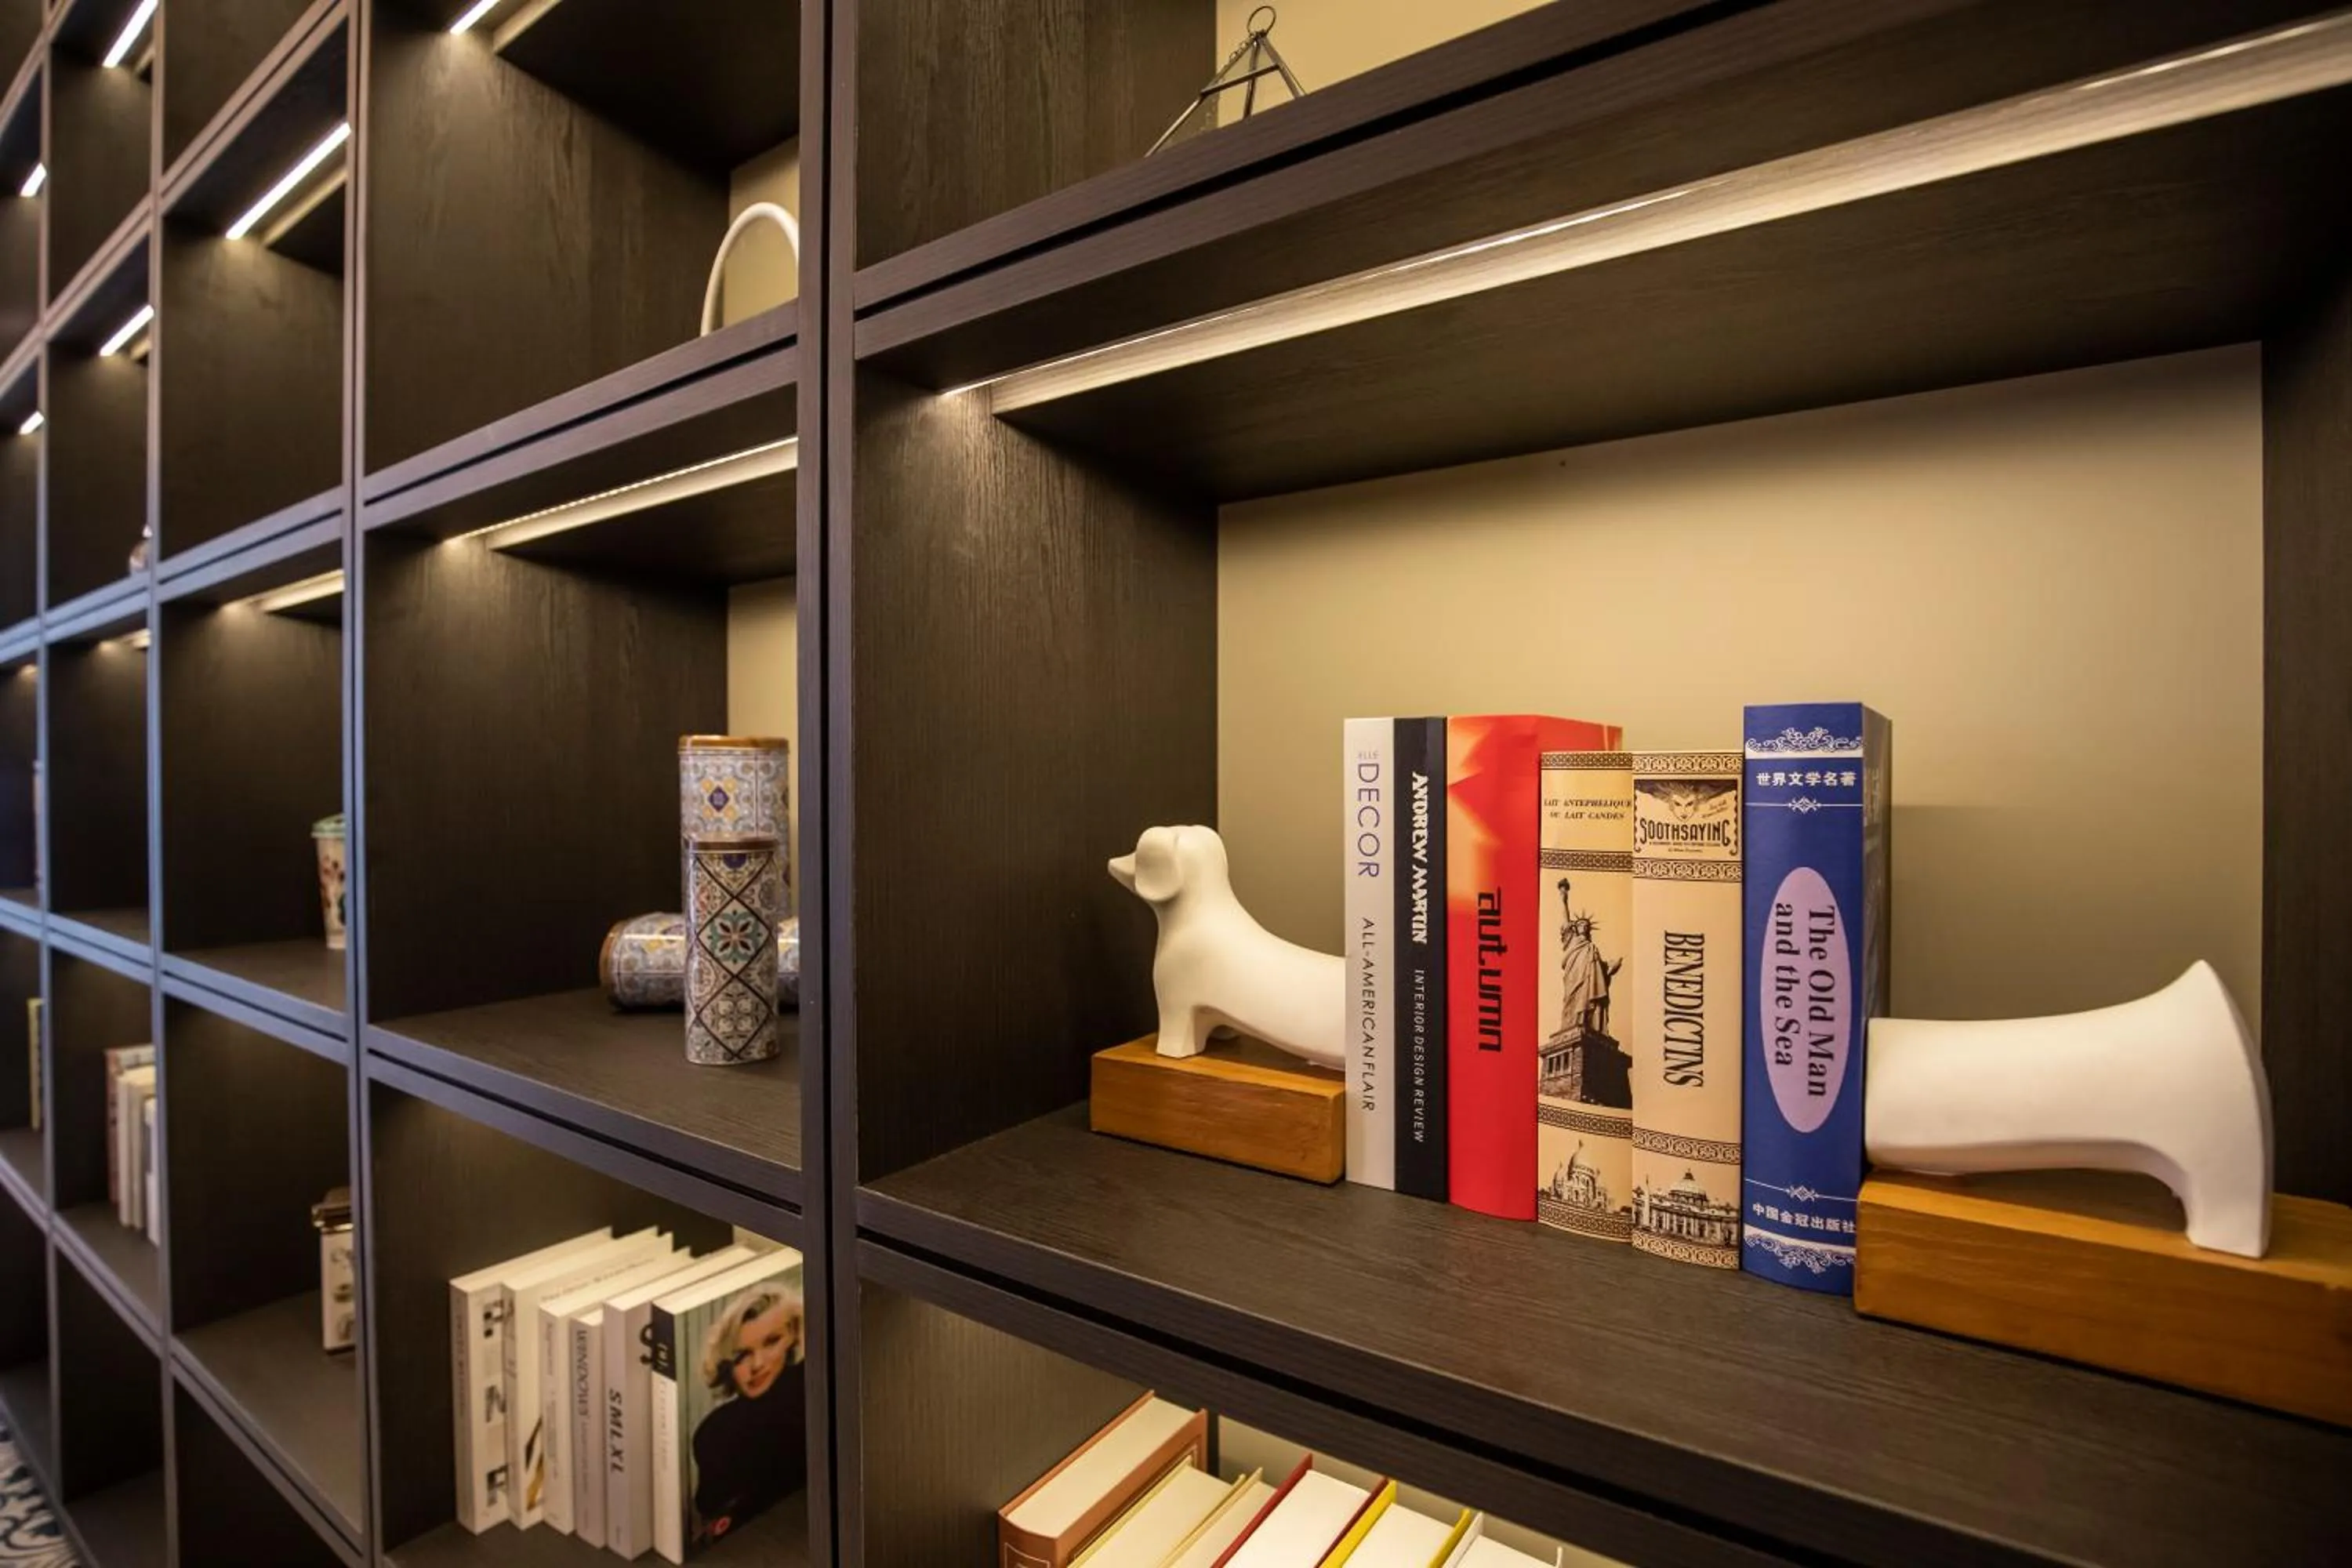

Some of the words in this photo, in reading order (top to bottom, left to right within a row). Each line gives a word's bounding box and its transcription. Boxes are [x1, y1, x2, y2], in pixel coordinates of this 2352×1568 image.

[1756, 771, 1857, 786] 世界文学名著
[1357, 762, 1381, 878] DECOR
[1412, 771, 1428, 862] ANDREW
[1639, 818, 1730, 847] SOOTHSAYING
[1412, 865, 1428, 944] MARTIN
[1775, 902, 1801, 956] and
[1809, 905, 1835, 960] The
[1478, 886, 1508, 1053] autumn
[1775, 965, 1801, 1009] the
[1808, 970, 1835, 1022] Old
[1414, 969, 1425, 1034] INTERIOR
[1663, 930, 1705, 1088] BENEDICTINS
[1414, 1037, 1425, 1087] DESIGN
[1775, 1016, 1801, 1066] Sea
[1808, 1033, 1835, 1098] Man
[1414, 1089, 1425, 1142] REVIEW
[1752, 1202, 1857, 1233] 中国金冠出版社
